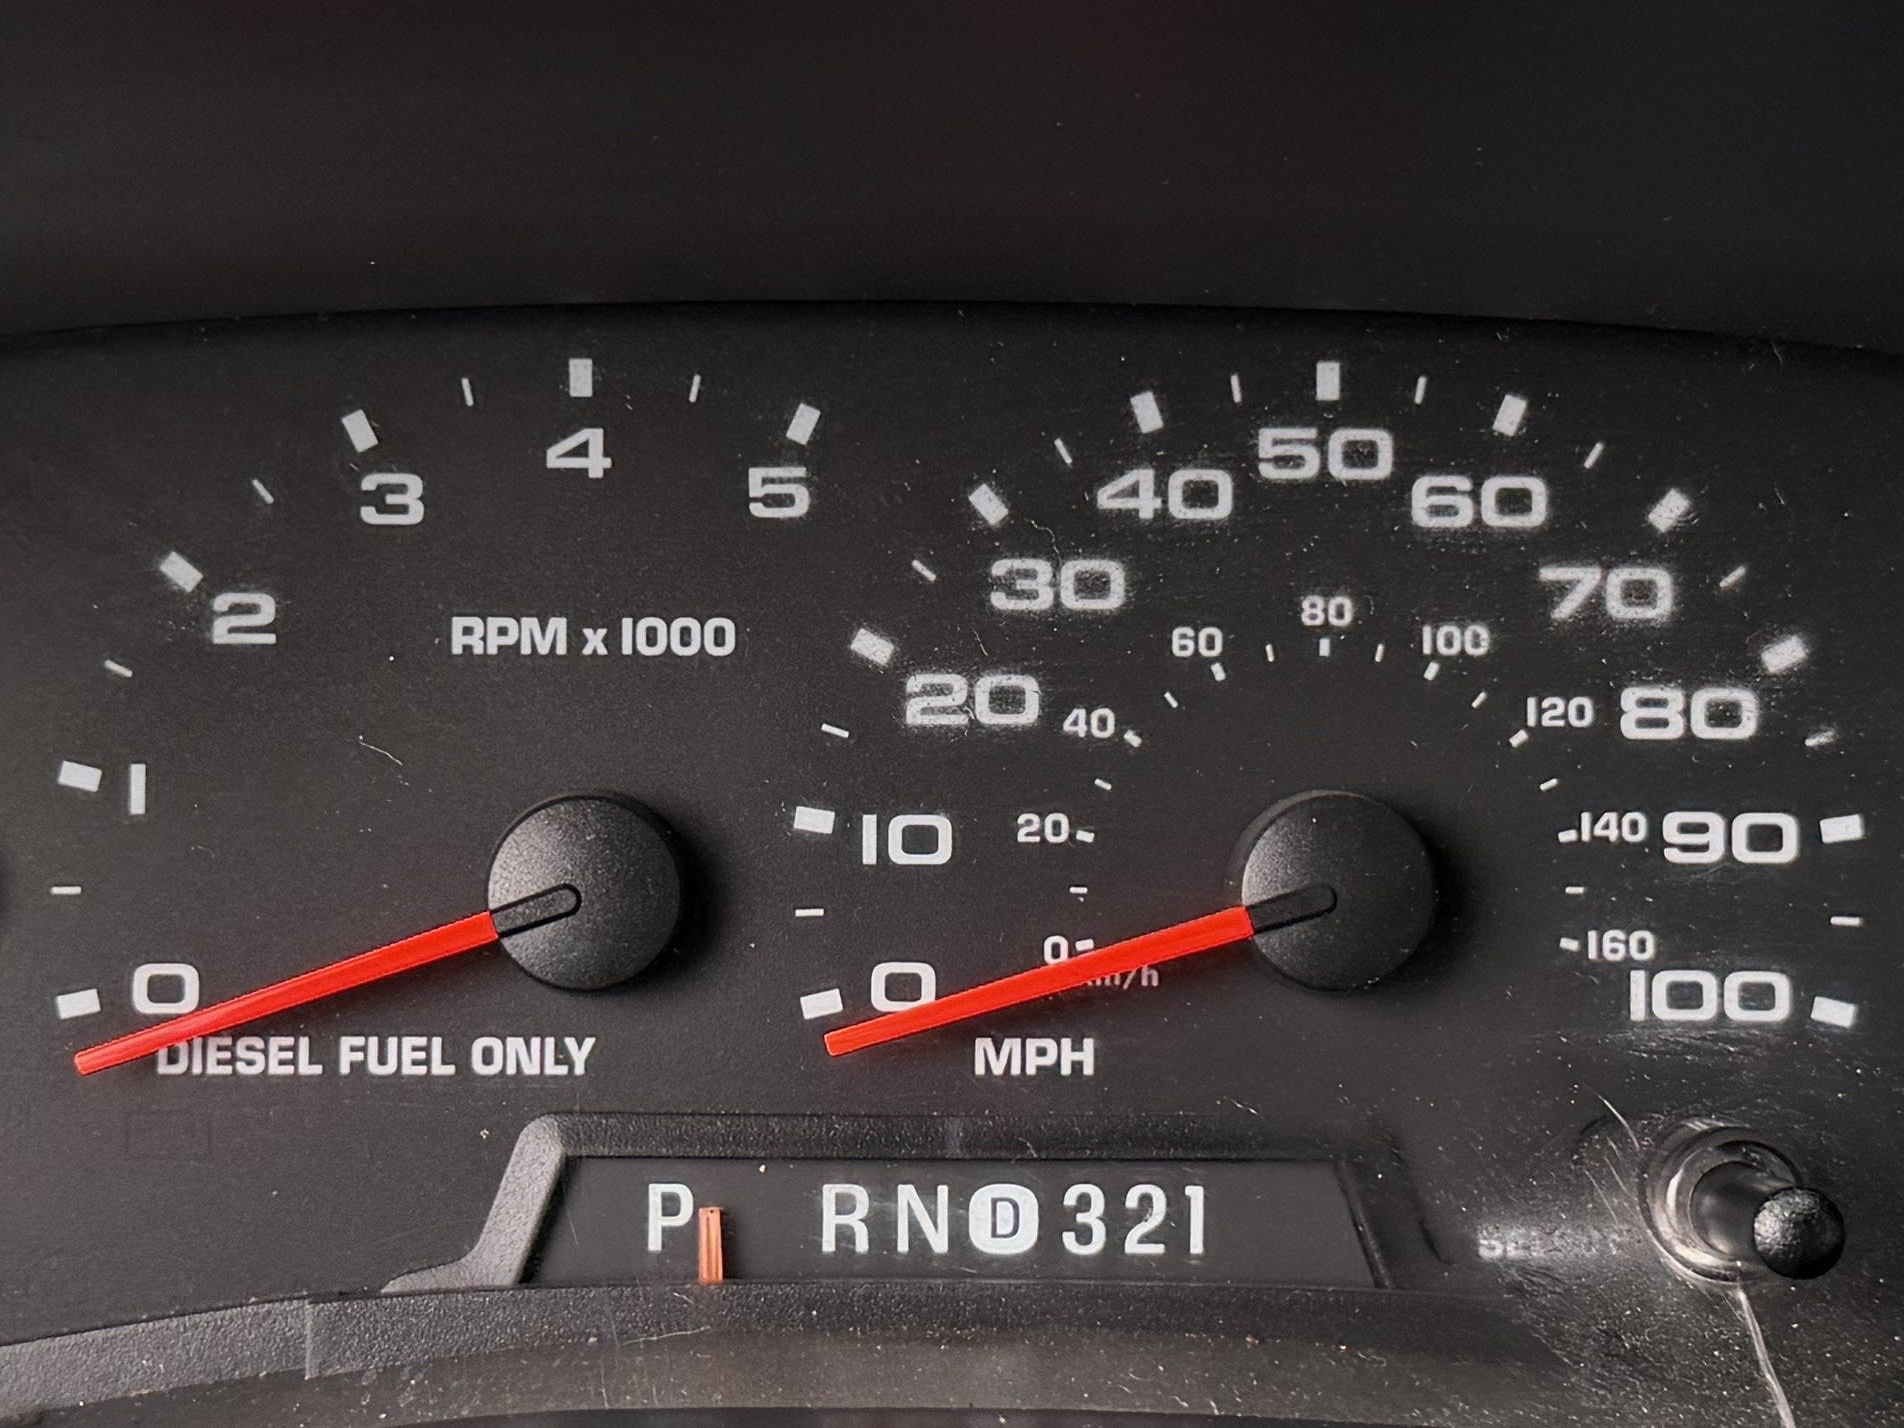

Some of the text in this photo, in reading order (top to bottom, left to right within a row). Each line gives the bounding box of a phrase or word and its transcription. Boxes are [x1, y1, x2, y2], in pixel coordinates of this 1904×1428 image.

[546, 427, 612, 479] 4
[1257, 427, 1394, 480] 50
[360, 472, 425, 526] 3
[748, 466, 811, 519] 5
[1096, 468, 1234, 522] 40
[1410, 475, 1548, 529] 60
[990, 557, 1127, 612] 30
[1300, 594, 1354, 627] 80
[1538, 565, 1674, 619] 70
[211, 592, 277, 645] 2
[451, 616, 568, 656] RPM
[621, 616, 736, 657] 1000
[1171, 626, 1223, 658] 60
[1422, 624, 1490, 657] 100
[905, 673, 1042, 728] 20
[1062, 707, 1116, 739] 40
[1526, 696, 1594, 728] 120
[1619, 684, 1760, 740] 80
[862, 814, 953, 865] 10
[1017, 812, 1070, 844] 20
[1580, 811, 1648, 843] 140
[1662, 811, 1799, 864] 90
[1043, 935, 1069, 965] 0
[1587, 929, 1656, 962] 160
[132, 963, 200, 1015] 0
[870, 961, 937, 1013] 0
[1629, 969, 1791, 1023] 100
[157, 1036, 596, 1076] DIESEL FUEL ONLY
[974, 1037, 1095, 1076] MPH
[647, 1183, 694, 1253] P
